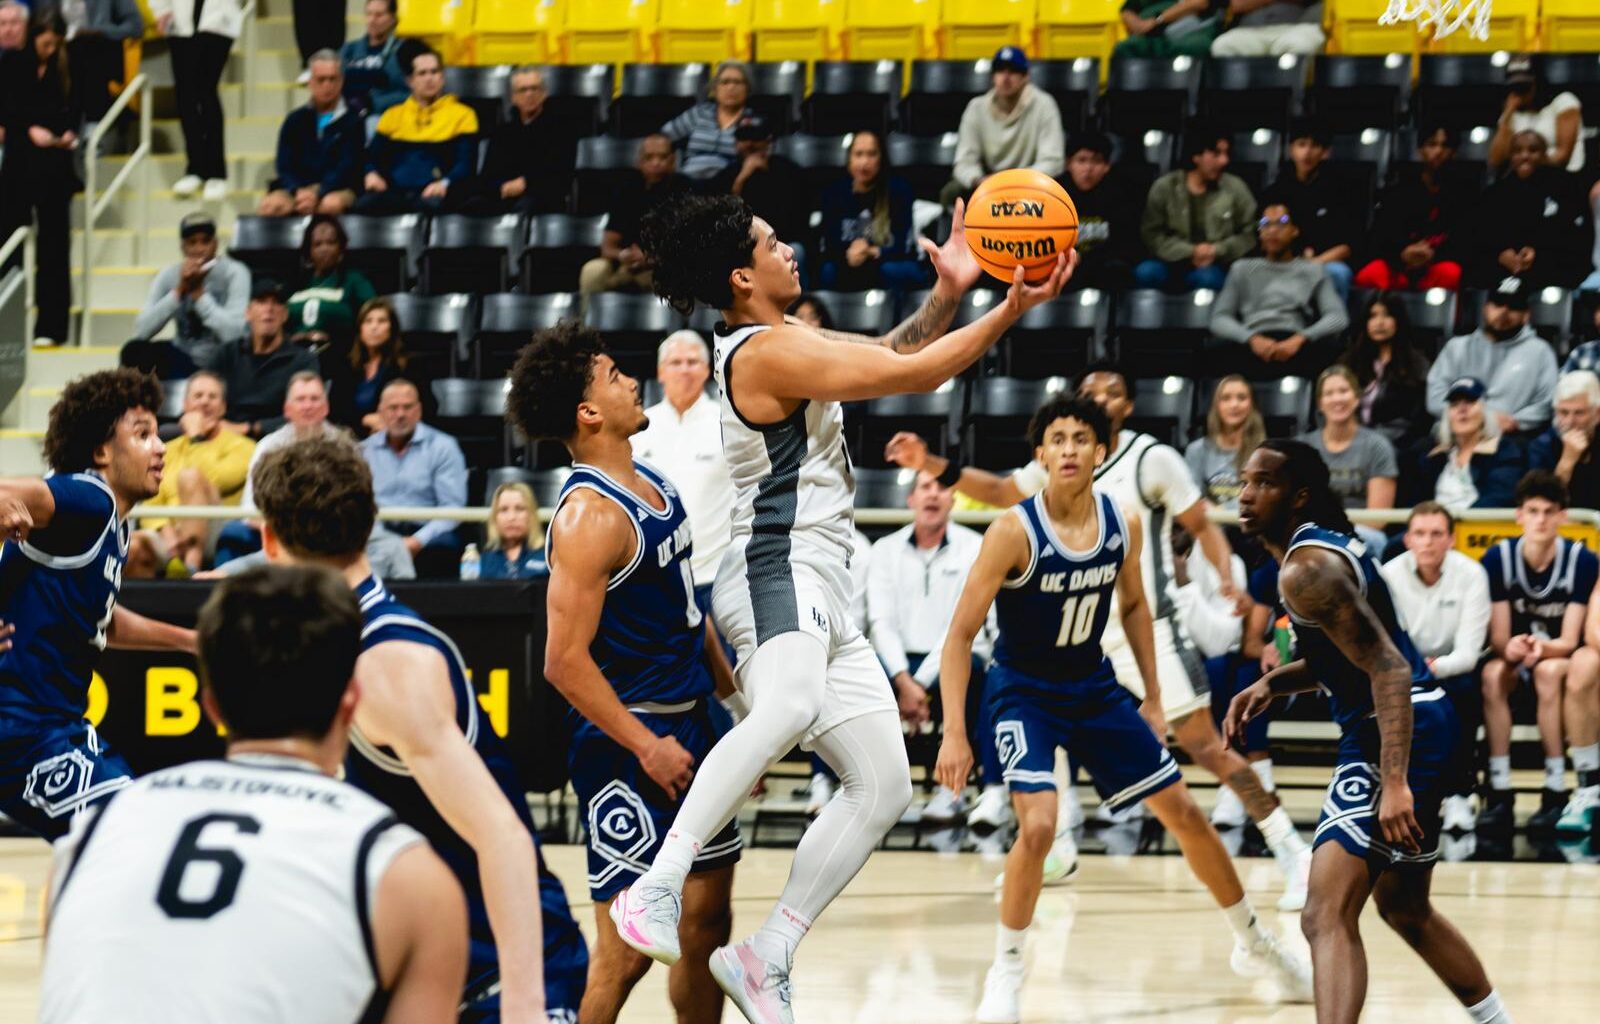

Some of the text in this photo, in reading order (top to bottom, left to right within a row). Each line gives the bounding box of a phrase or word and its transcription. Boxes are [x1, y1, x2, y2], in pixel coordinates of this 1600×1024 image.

[991, 201, 1045, 218] NCAA
[980, 235, 1057, 260] Wilson
[1040, 562, 1118, 593] UC DAVIS
[1055, 593, 1100, 647] 10
[154, 810, 263, 920] 6
